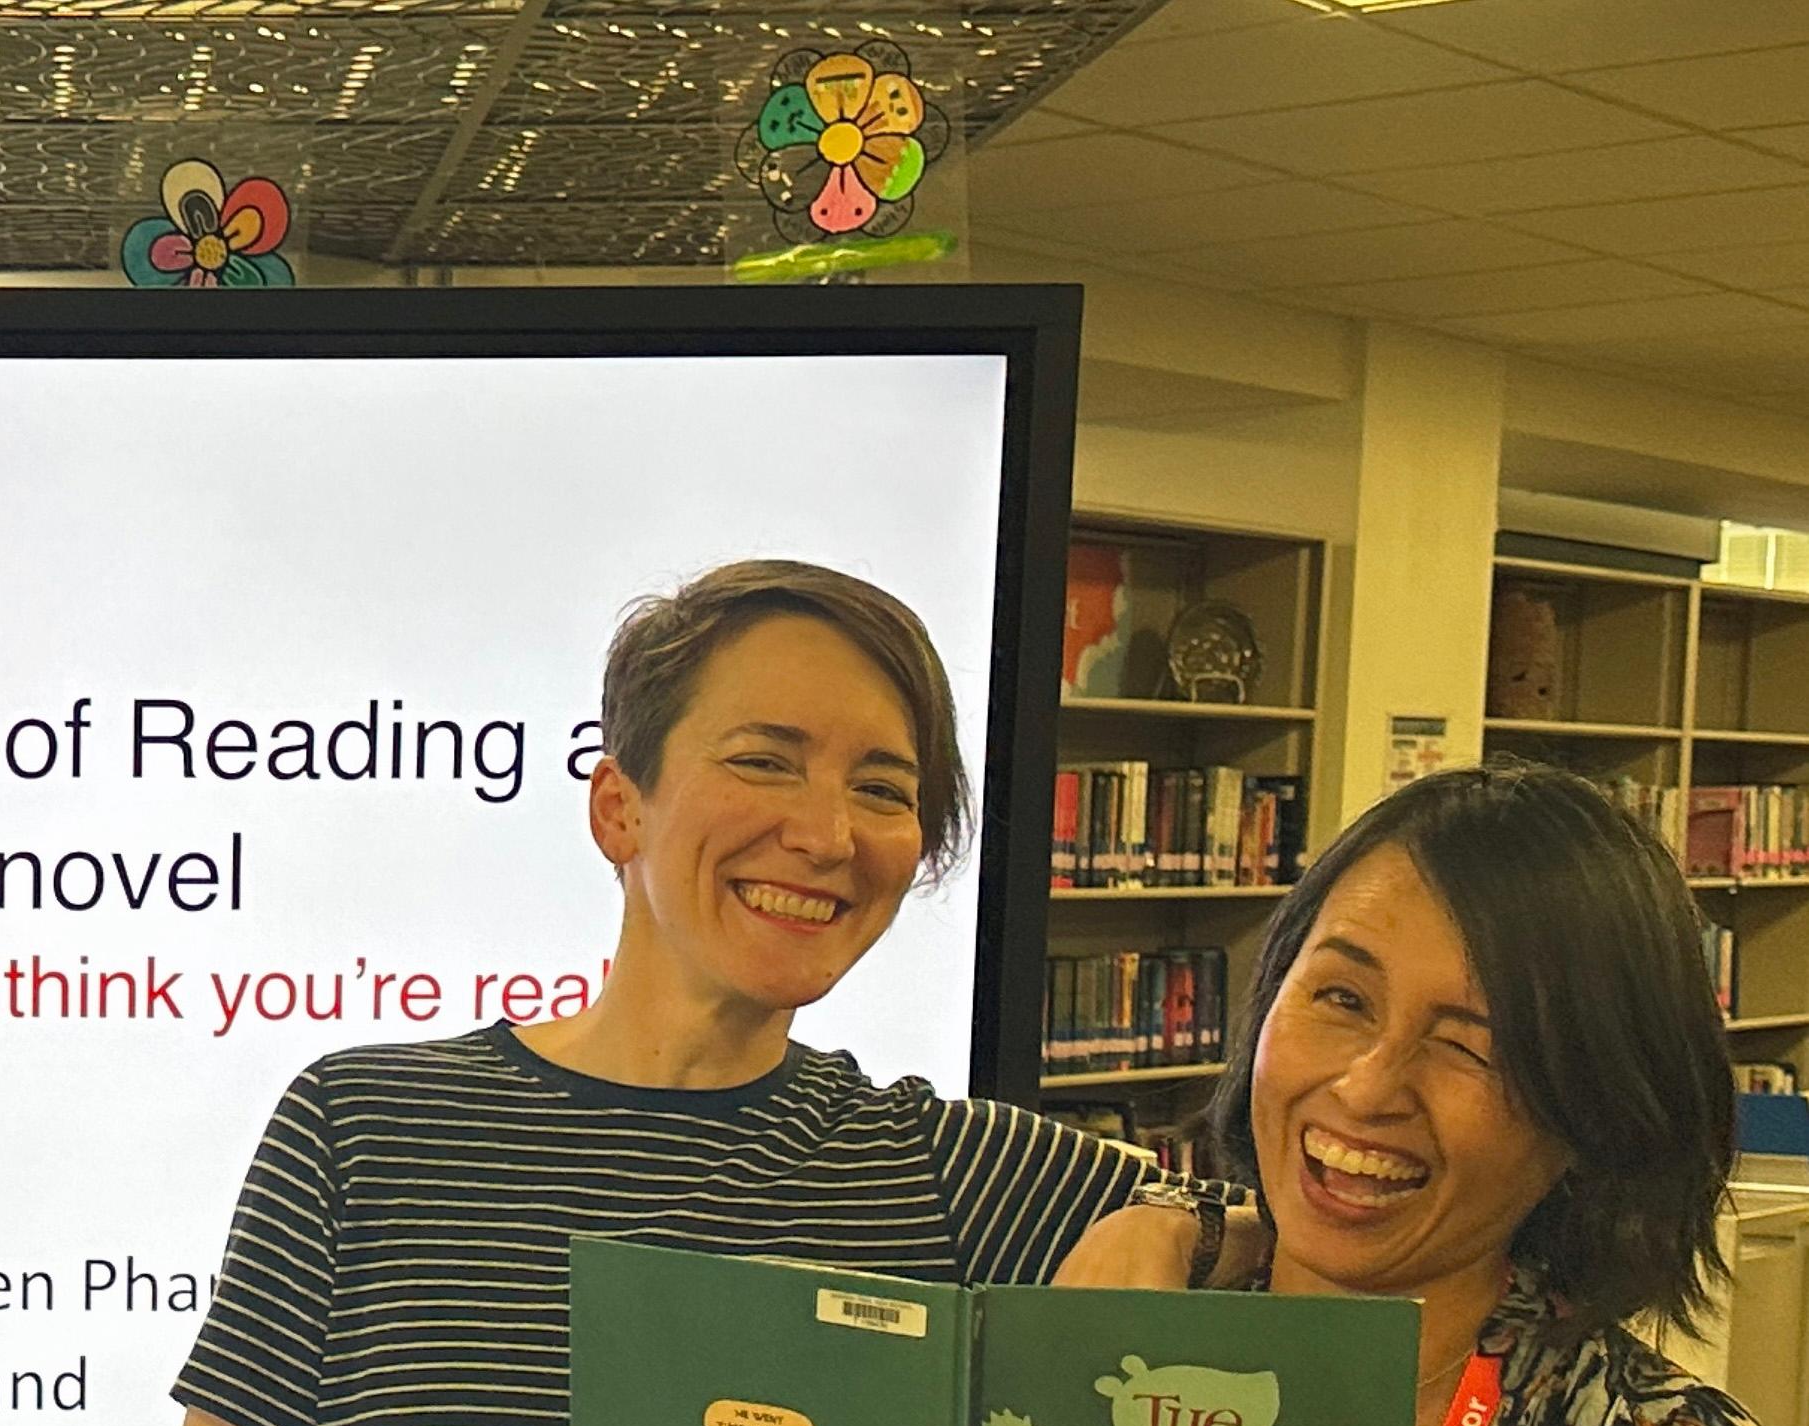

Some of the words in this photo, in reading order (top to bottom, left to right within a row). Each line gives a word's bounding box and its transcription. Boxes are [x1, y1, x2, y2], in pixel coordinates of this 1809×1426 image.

[5, 697, 92, 780] of
[132, 699, 525, 804] Reading
[3, 955, 183, 1019] think
[84, 1255, 219, 1312] Pha
